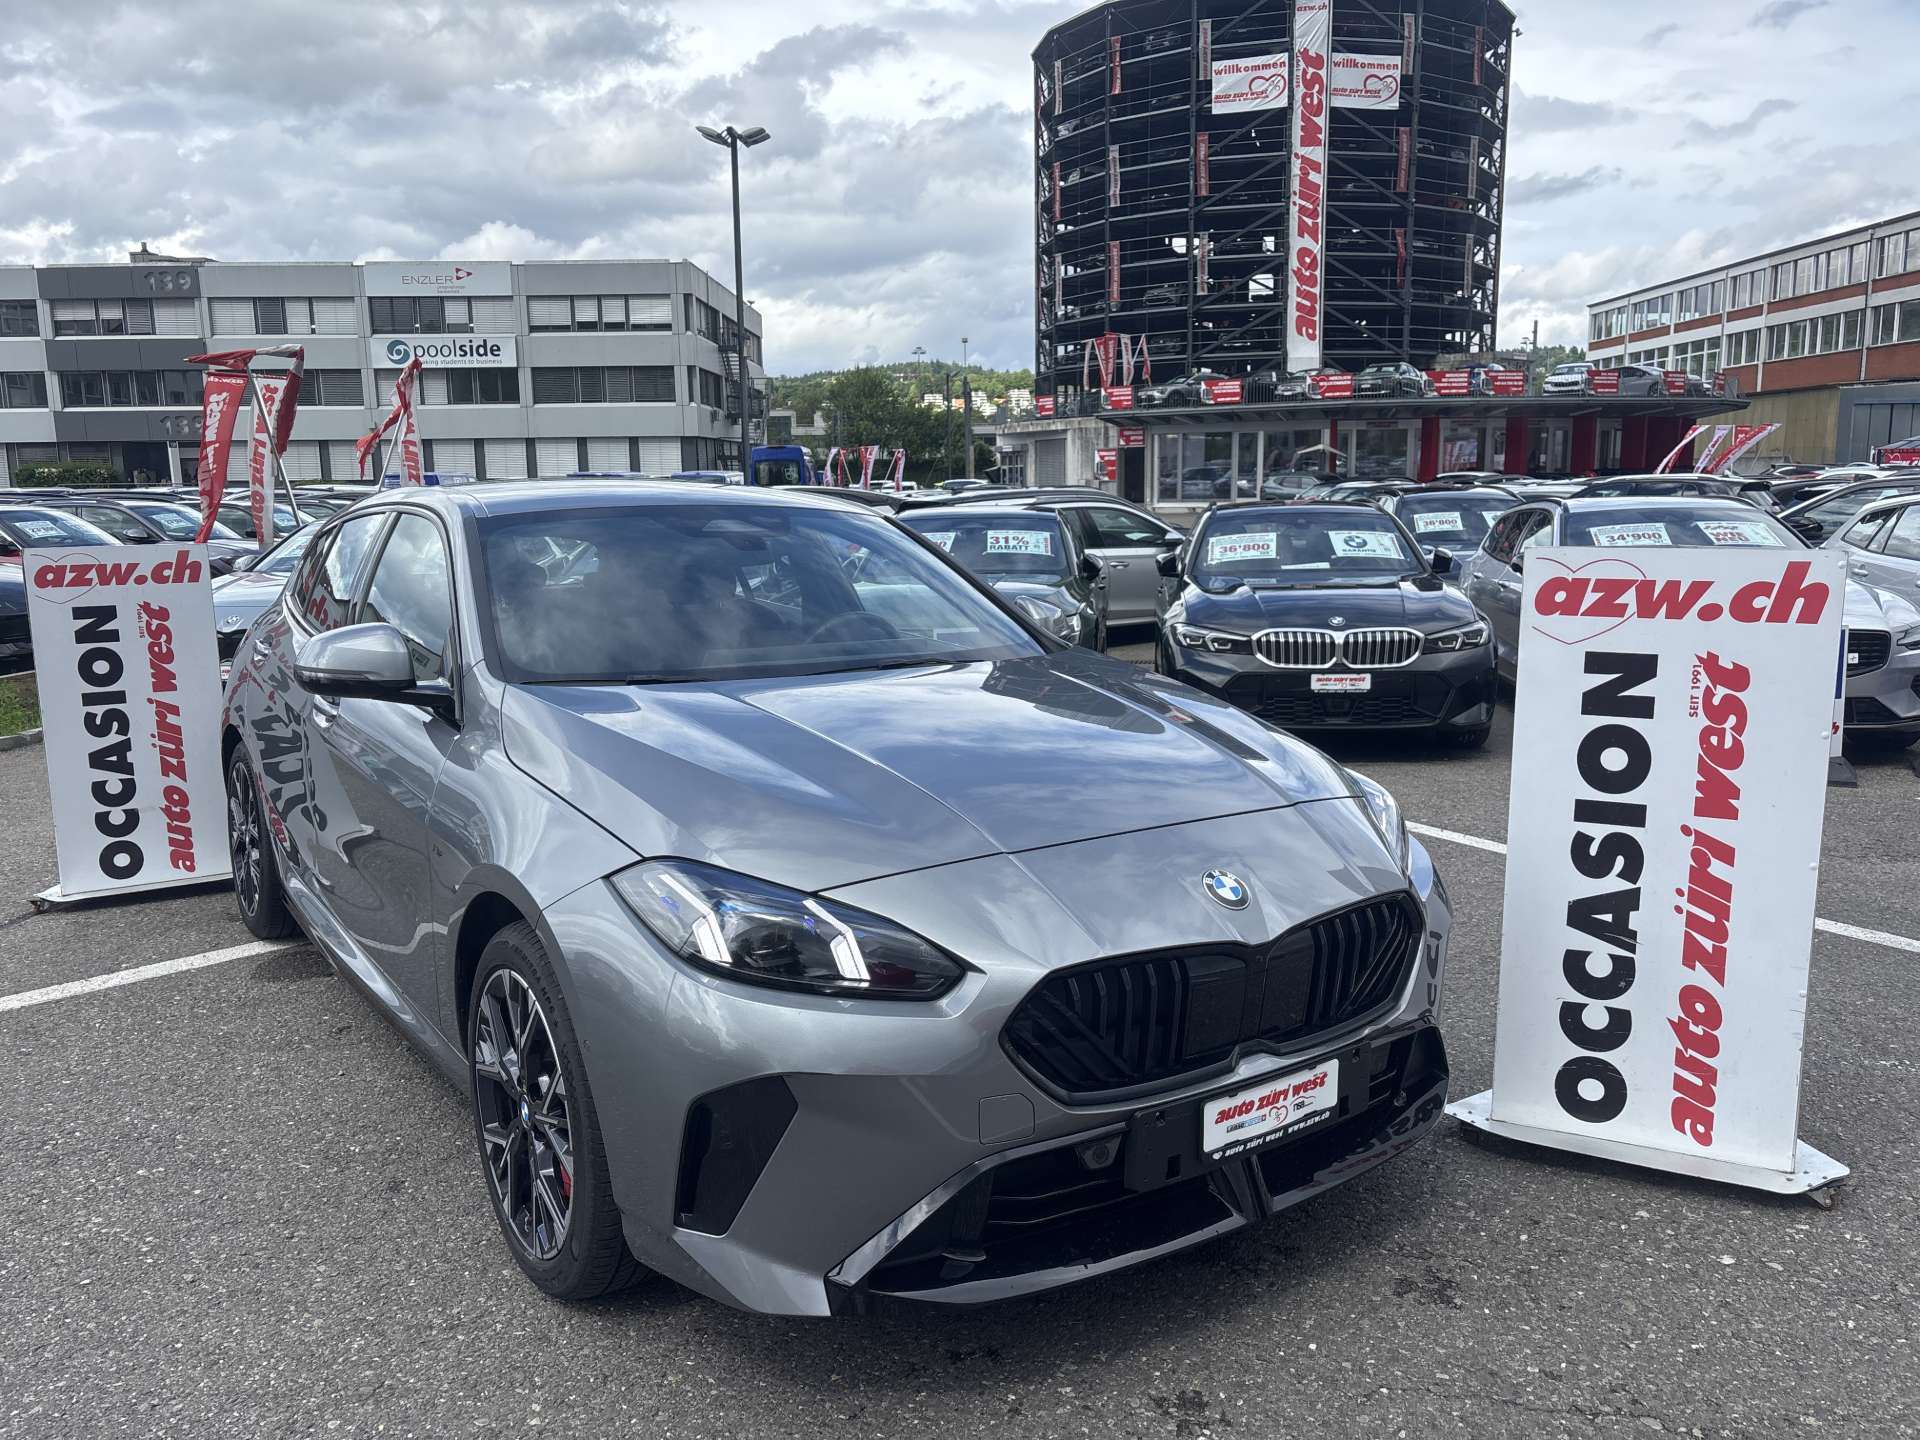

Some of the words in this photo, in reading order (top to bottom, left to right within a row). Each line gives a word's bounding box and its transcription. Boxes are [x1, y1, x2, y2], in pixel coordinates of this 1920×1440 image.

[1297, 2, 1327, 11] azw.ch
[1214, 61, 1286, 76] willkommen
[1333, 58, 1399, 70] willkommen
[1299, 47, 1325, 147] west
[1292, 151, 1322, 245] züri
[144, 271, 192, 291] 139
[401, 275, 453, 285] ENZLER
[1292, 246, 1319, 343] auto
[413, 339, 501, 358] poolside
[989, 535, 1029, 545] 31%
[1218, 543, 1270, 554] 36'800
[1606, 532, 1663, 543] 34'900
[33, 550, 202, 589] azw.ch
[1533, 561, 1831, 625] azw.ch
[137, 600, 178, 693] west
[1691, 664, 1702, 691] 1991
[1689, 694, 1700, 718] SEIT
[72, 604, 145, 880] OCCASION
[147, 697, 188, 784] züri
[1693, 649, 1752, 822] west
[159, 784, 196, 873] auto
[1554, 651, 1659, 1124] OCCASION
[1673, 823, 1737, 989] züri
[1666, 984, 1724, 1147] auto
[1215, 1100, 1255, 1124] auto
[1256, 1083, 1291, 1111] züri
[1292, 1071, 1329, 1098] west
[1224, 1144, 1244, 1157] auto
[1245, 1136, 1264, 1150] züri
[1265, 1129, 1284, 1142] west
